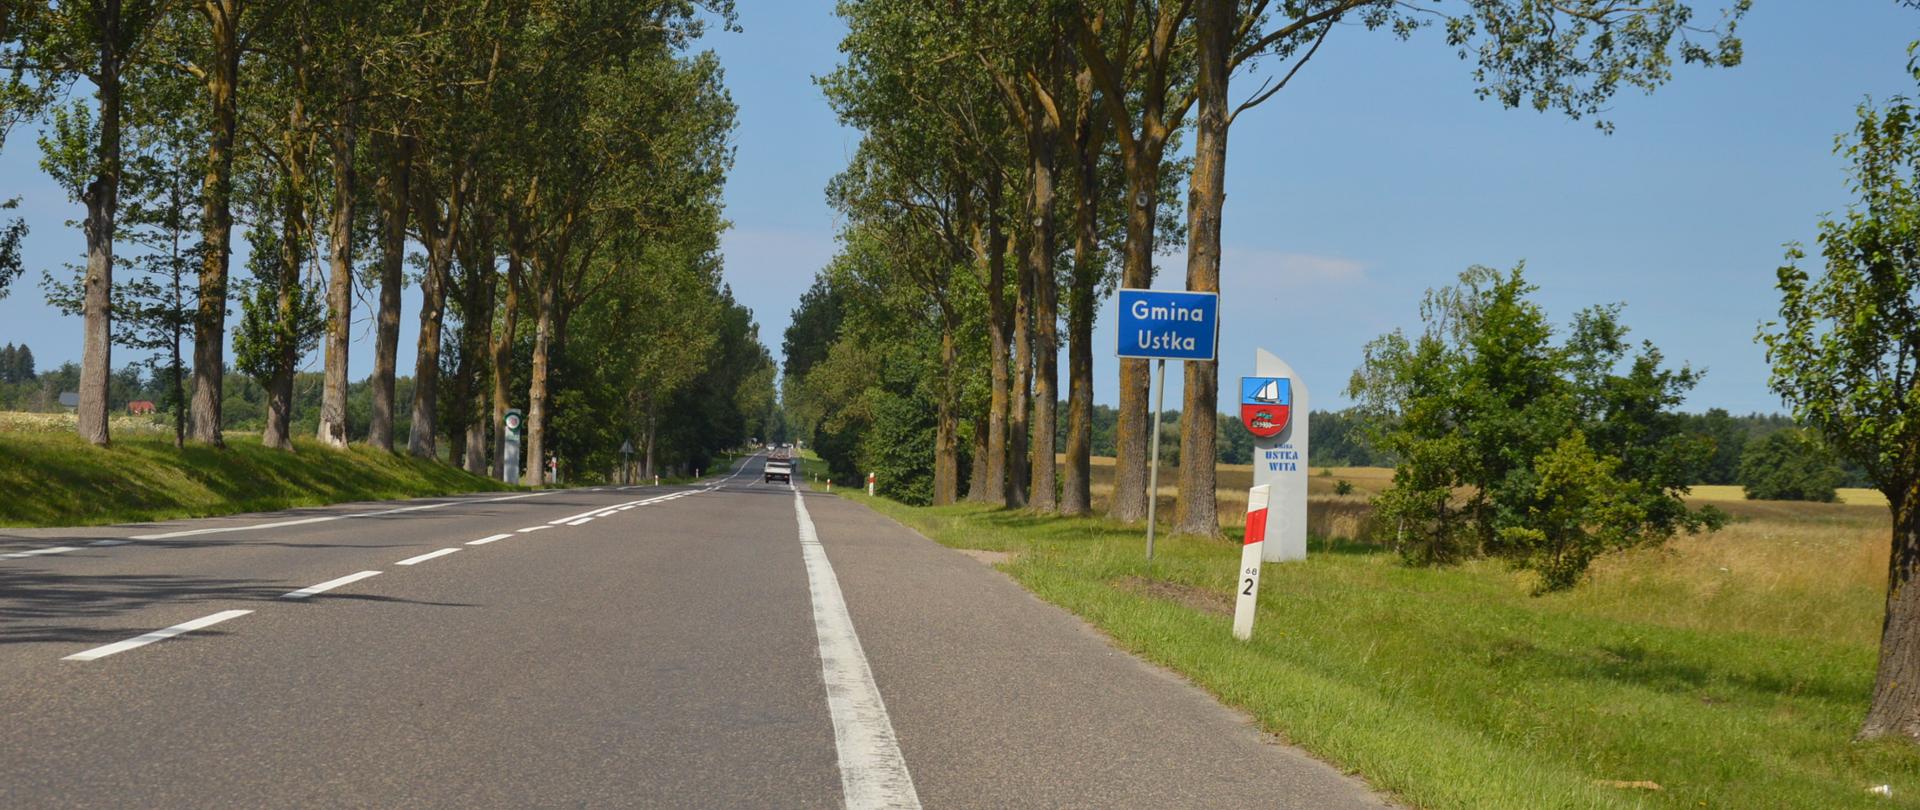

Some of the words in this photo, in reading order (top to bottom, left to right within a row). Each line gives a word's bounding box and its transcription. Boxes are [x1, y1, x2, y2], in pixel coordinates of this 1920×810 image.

[1132, 300, 1203, 322] Gmina
[1138, 329, 1195, 350] Ustka
[1265, 451, 1298, 460] USTKA
[1269, 462, 1296, 471] WITA
[1245, 568, 1257, 576] 68
[1242, 578, 1254, 596] 2
